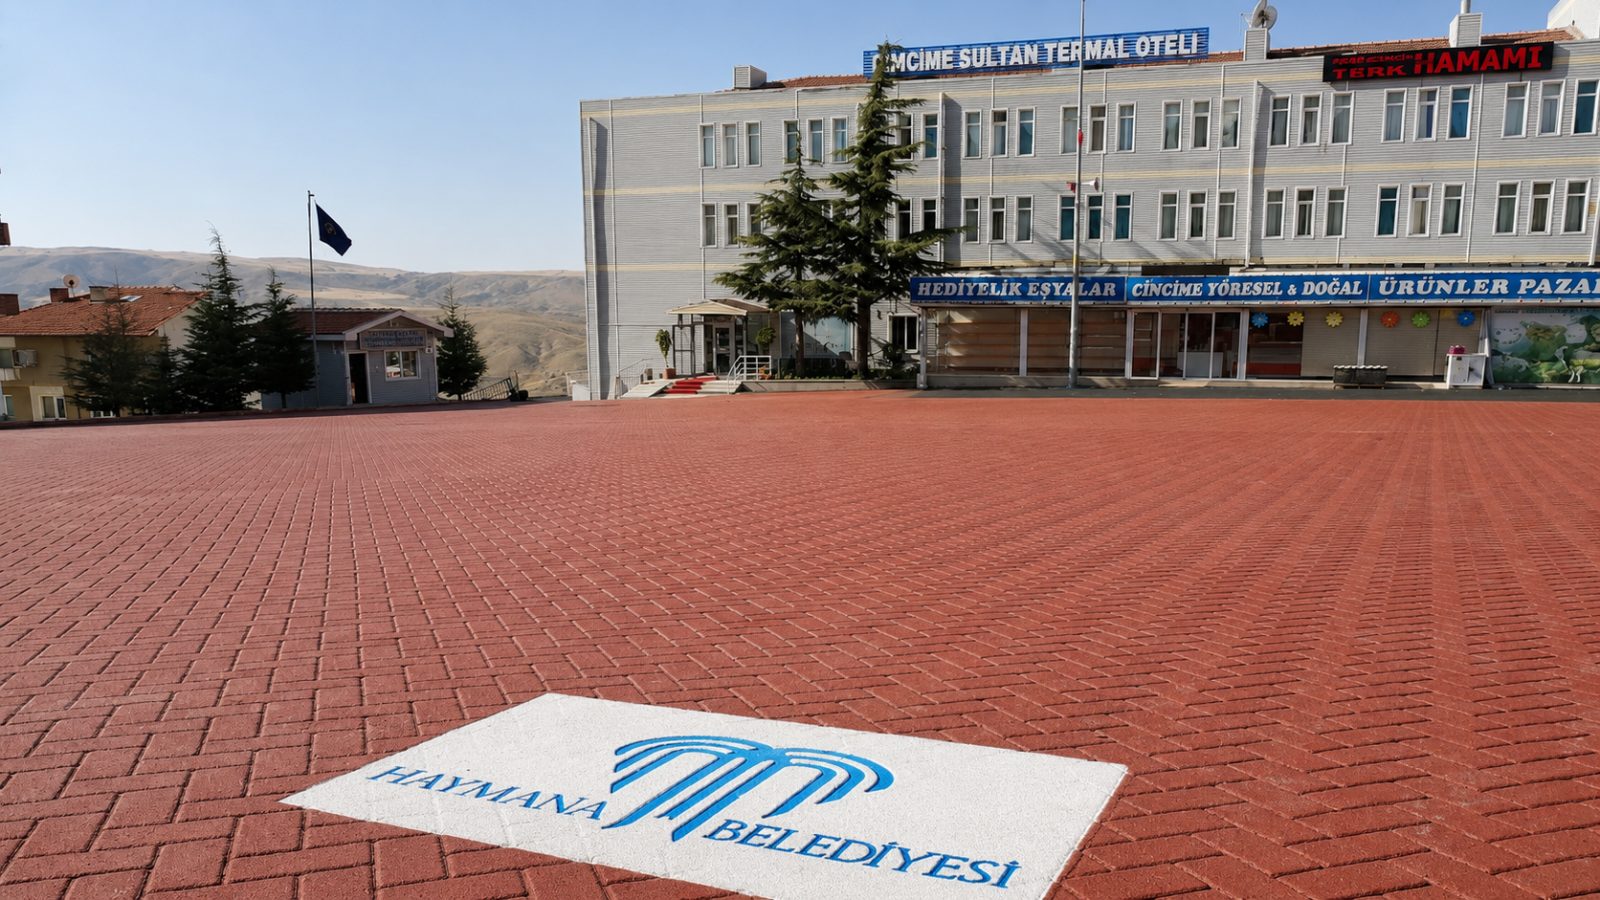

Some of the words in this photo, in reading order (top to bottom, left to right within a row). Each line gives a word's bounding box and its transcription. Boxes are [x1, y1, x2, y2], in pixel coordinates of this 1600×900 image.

[872, 48, 955, 73] CMCİME
[959, 44, 1039, 69] SULTAN
[1044, 38, 1130, 63] TERMAL
[917, 279, 1023, 297] HEDİYELİK
[1026, 281, 1117, 300] EŞYALAR
[1207, 278, 1283, 297] YÖRESEL
[1287, 284, 1298, 296] &
[1301, 277, 1364, 296] DOĞAL
[1378, 276, 1510, 296] ÜRÜNLER
[367, 766, 607, 820] HAYMANA
[702, 818, 1022, 889] BELEDİYESİ
